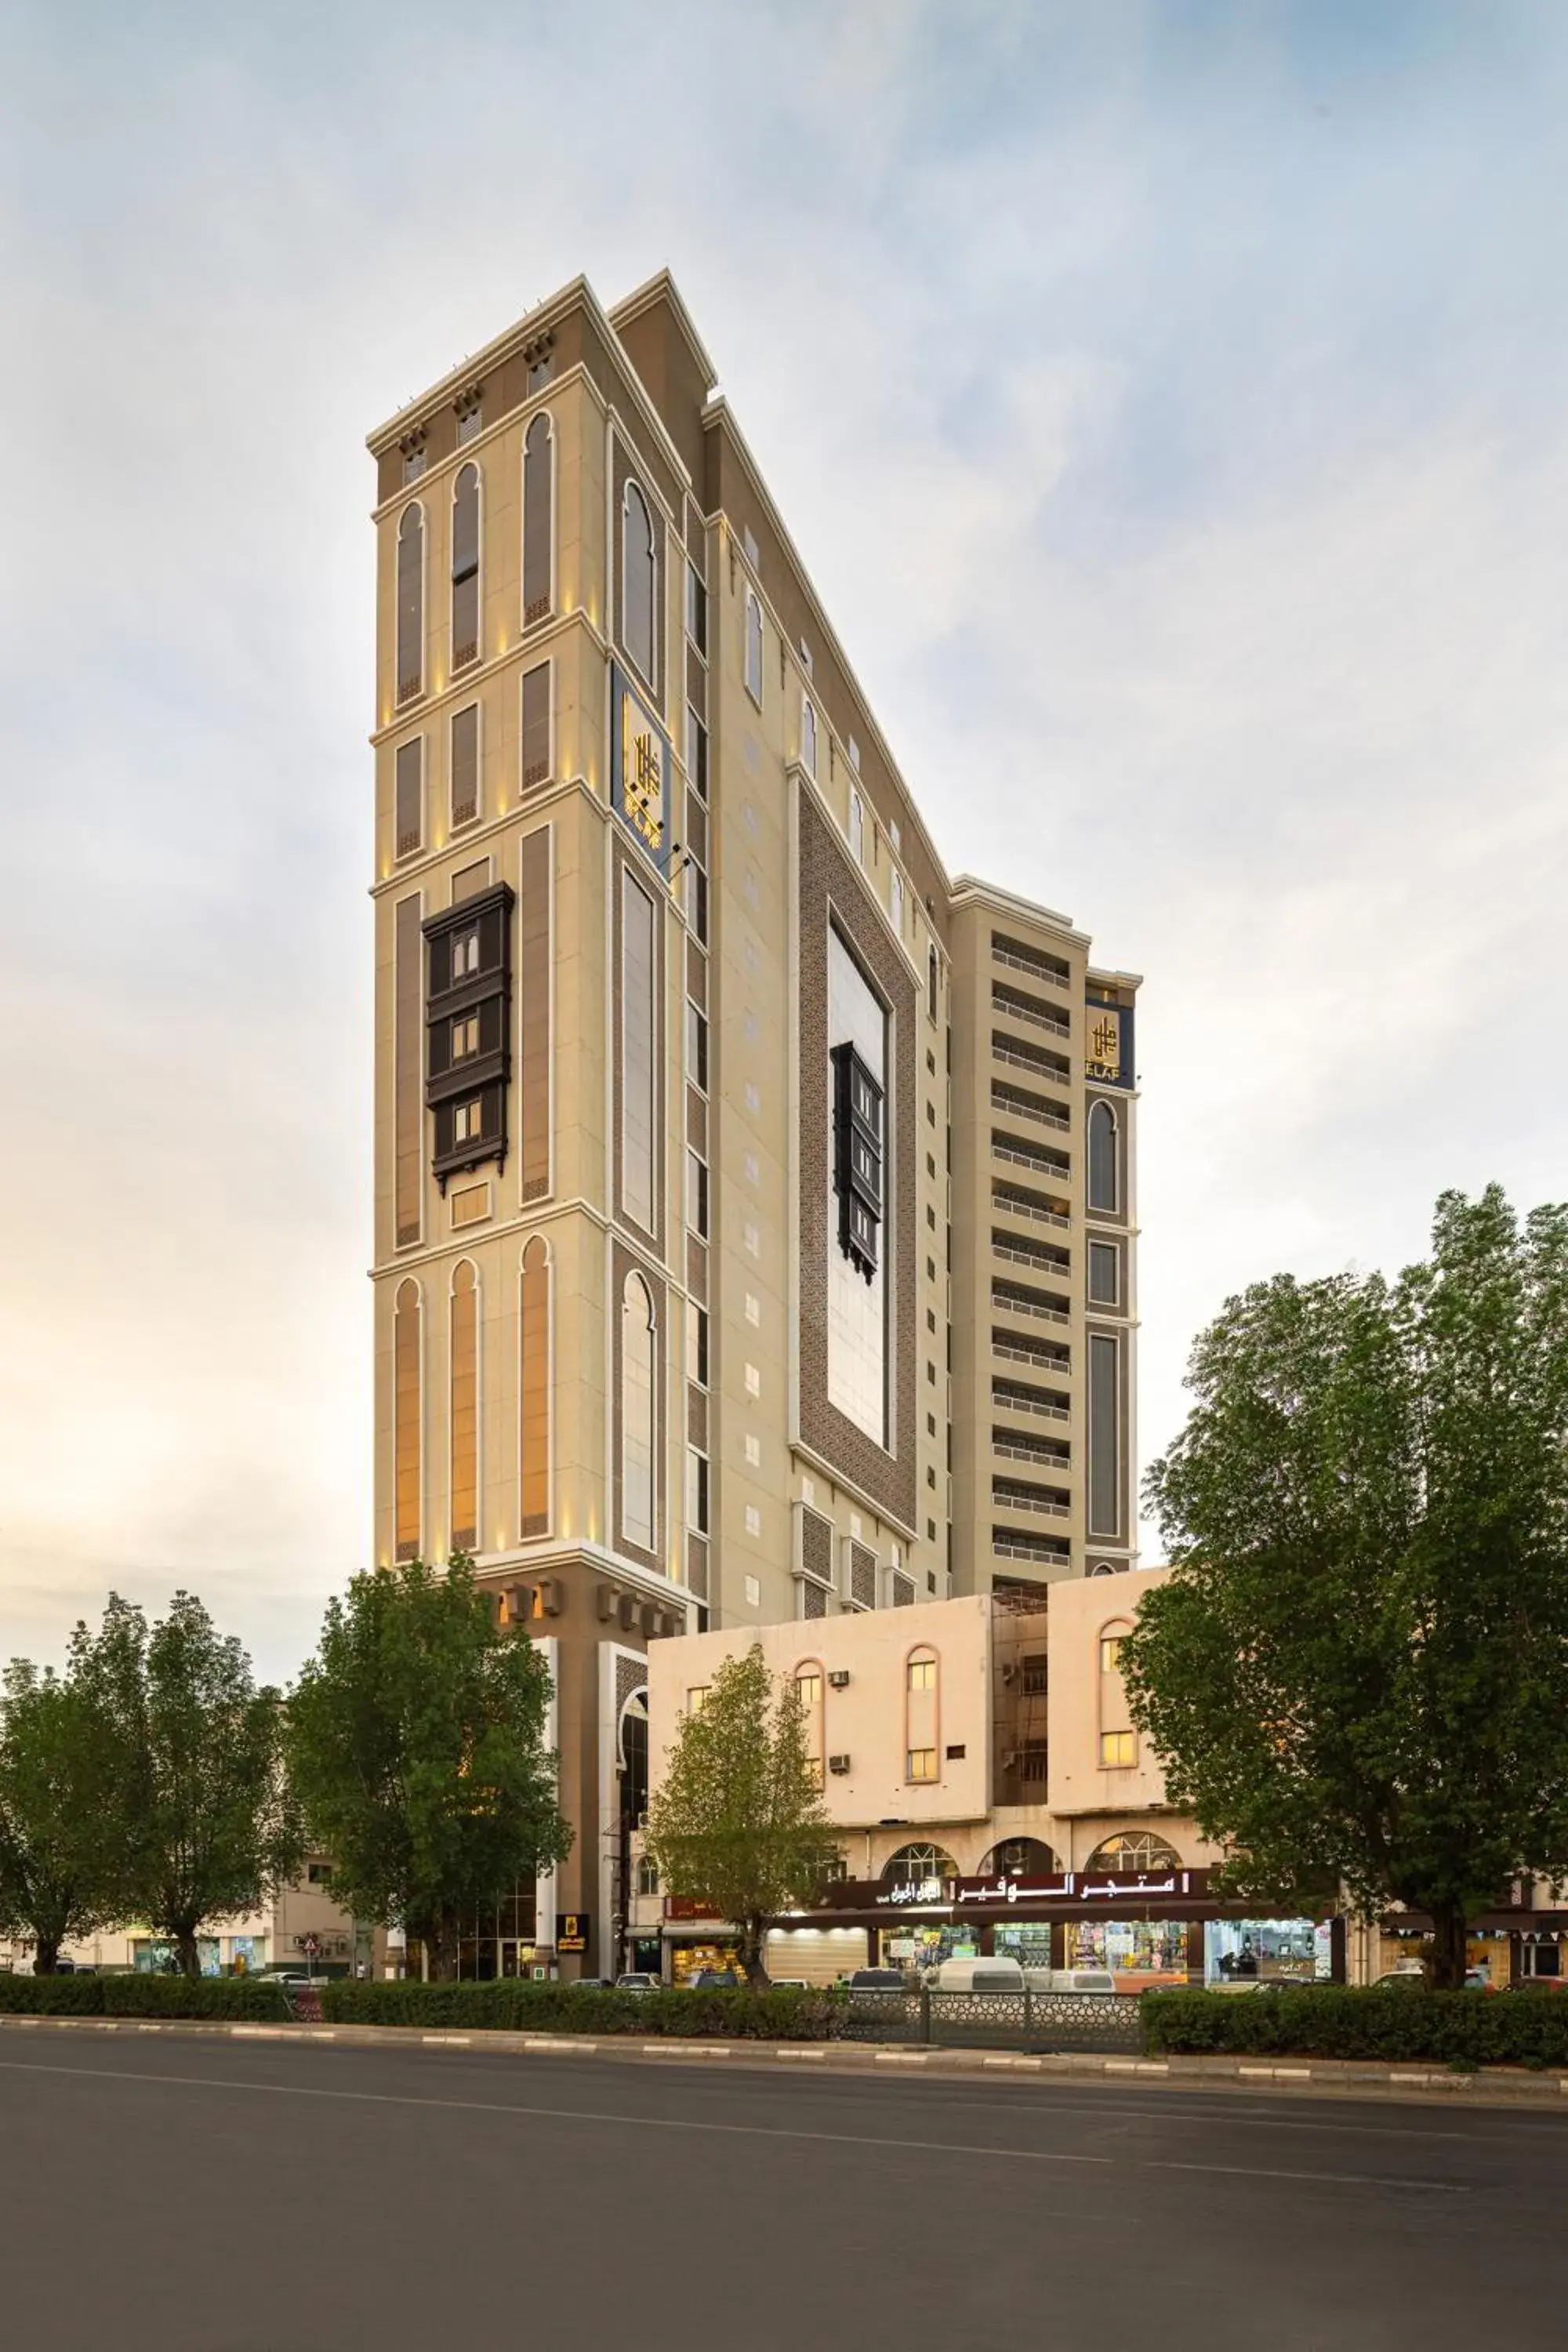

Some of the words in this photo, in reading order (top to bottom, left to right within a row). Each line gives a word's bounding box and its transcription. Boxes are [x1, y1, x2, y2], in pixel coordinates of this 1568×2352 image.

[1086, 1063, 1120, 1081] ELAF
[958, 1873, 1075, 1902] الوفير
[1080, 1875, 1174, 1899] متجر
